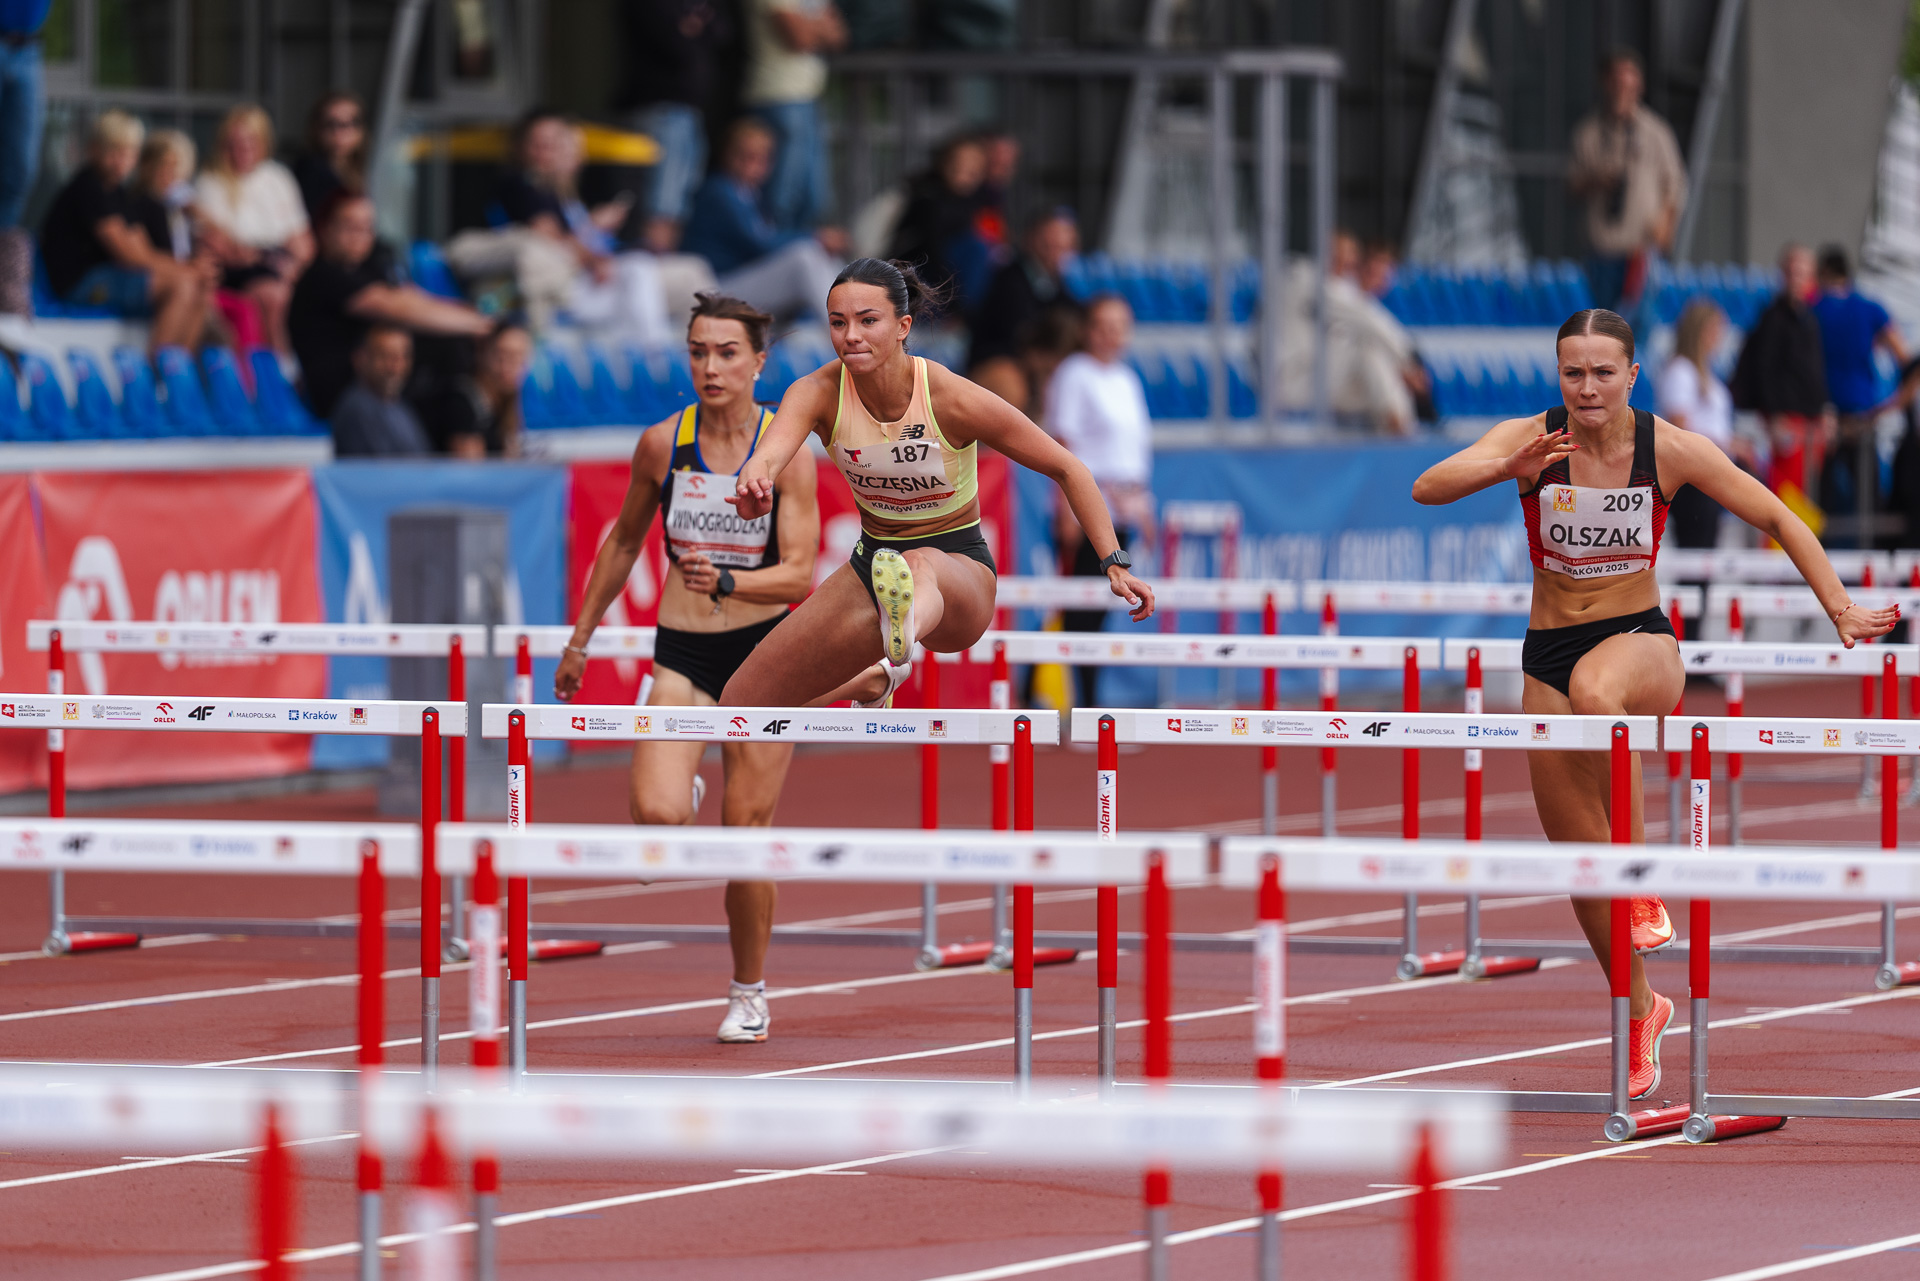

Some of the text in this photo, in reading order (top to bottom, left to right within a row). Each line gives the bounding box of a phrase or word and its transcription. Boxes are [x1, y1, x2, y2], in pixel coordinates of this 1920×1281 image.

[891, 444, 930, 464] 187
[843, 459, 872, 469] TRYUMF
[845, 469, 946, 494] SZCZĘSNA
[871, 502, 939, 513] KRAKÓW 2025
[1554, 503, 1576, 512] PZLA
[1602, 493, 1644, 512] 209
[672, 509, 767, 535] WINOGRODZKA
[1549, 523, 1642, 547] OLSZAK
[1572, 556, 1610, 565] Mistrzostwa
[1562, 562, 1629, 576] KRAKÓW 2025
[188, 706, 216, 721] 4F
[303, 711, 338, 720] Kraków
[763, 720, 791, 735] 4F
[881, 724, 916, 733] Kraków
[1362, 722, 1391, 737] 4F
[1482, 727, 1519, 736] Kraków
[509, 788, 519, 833] olanik
[1693, 803, 1704, 853] polanik
